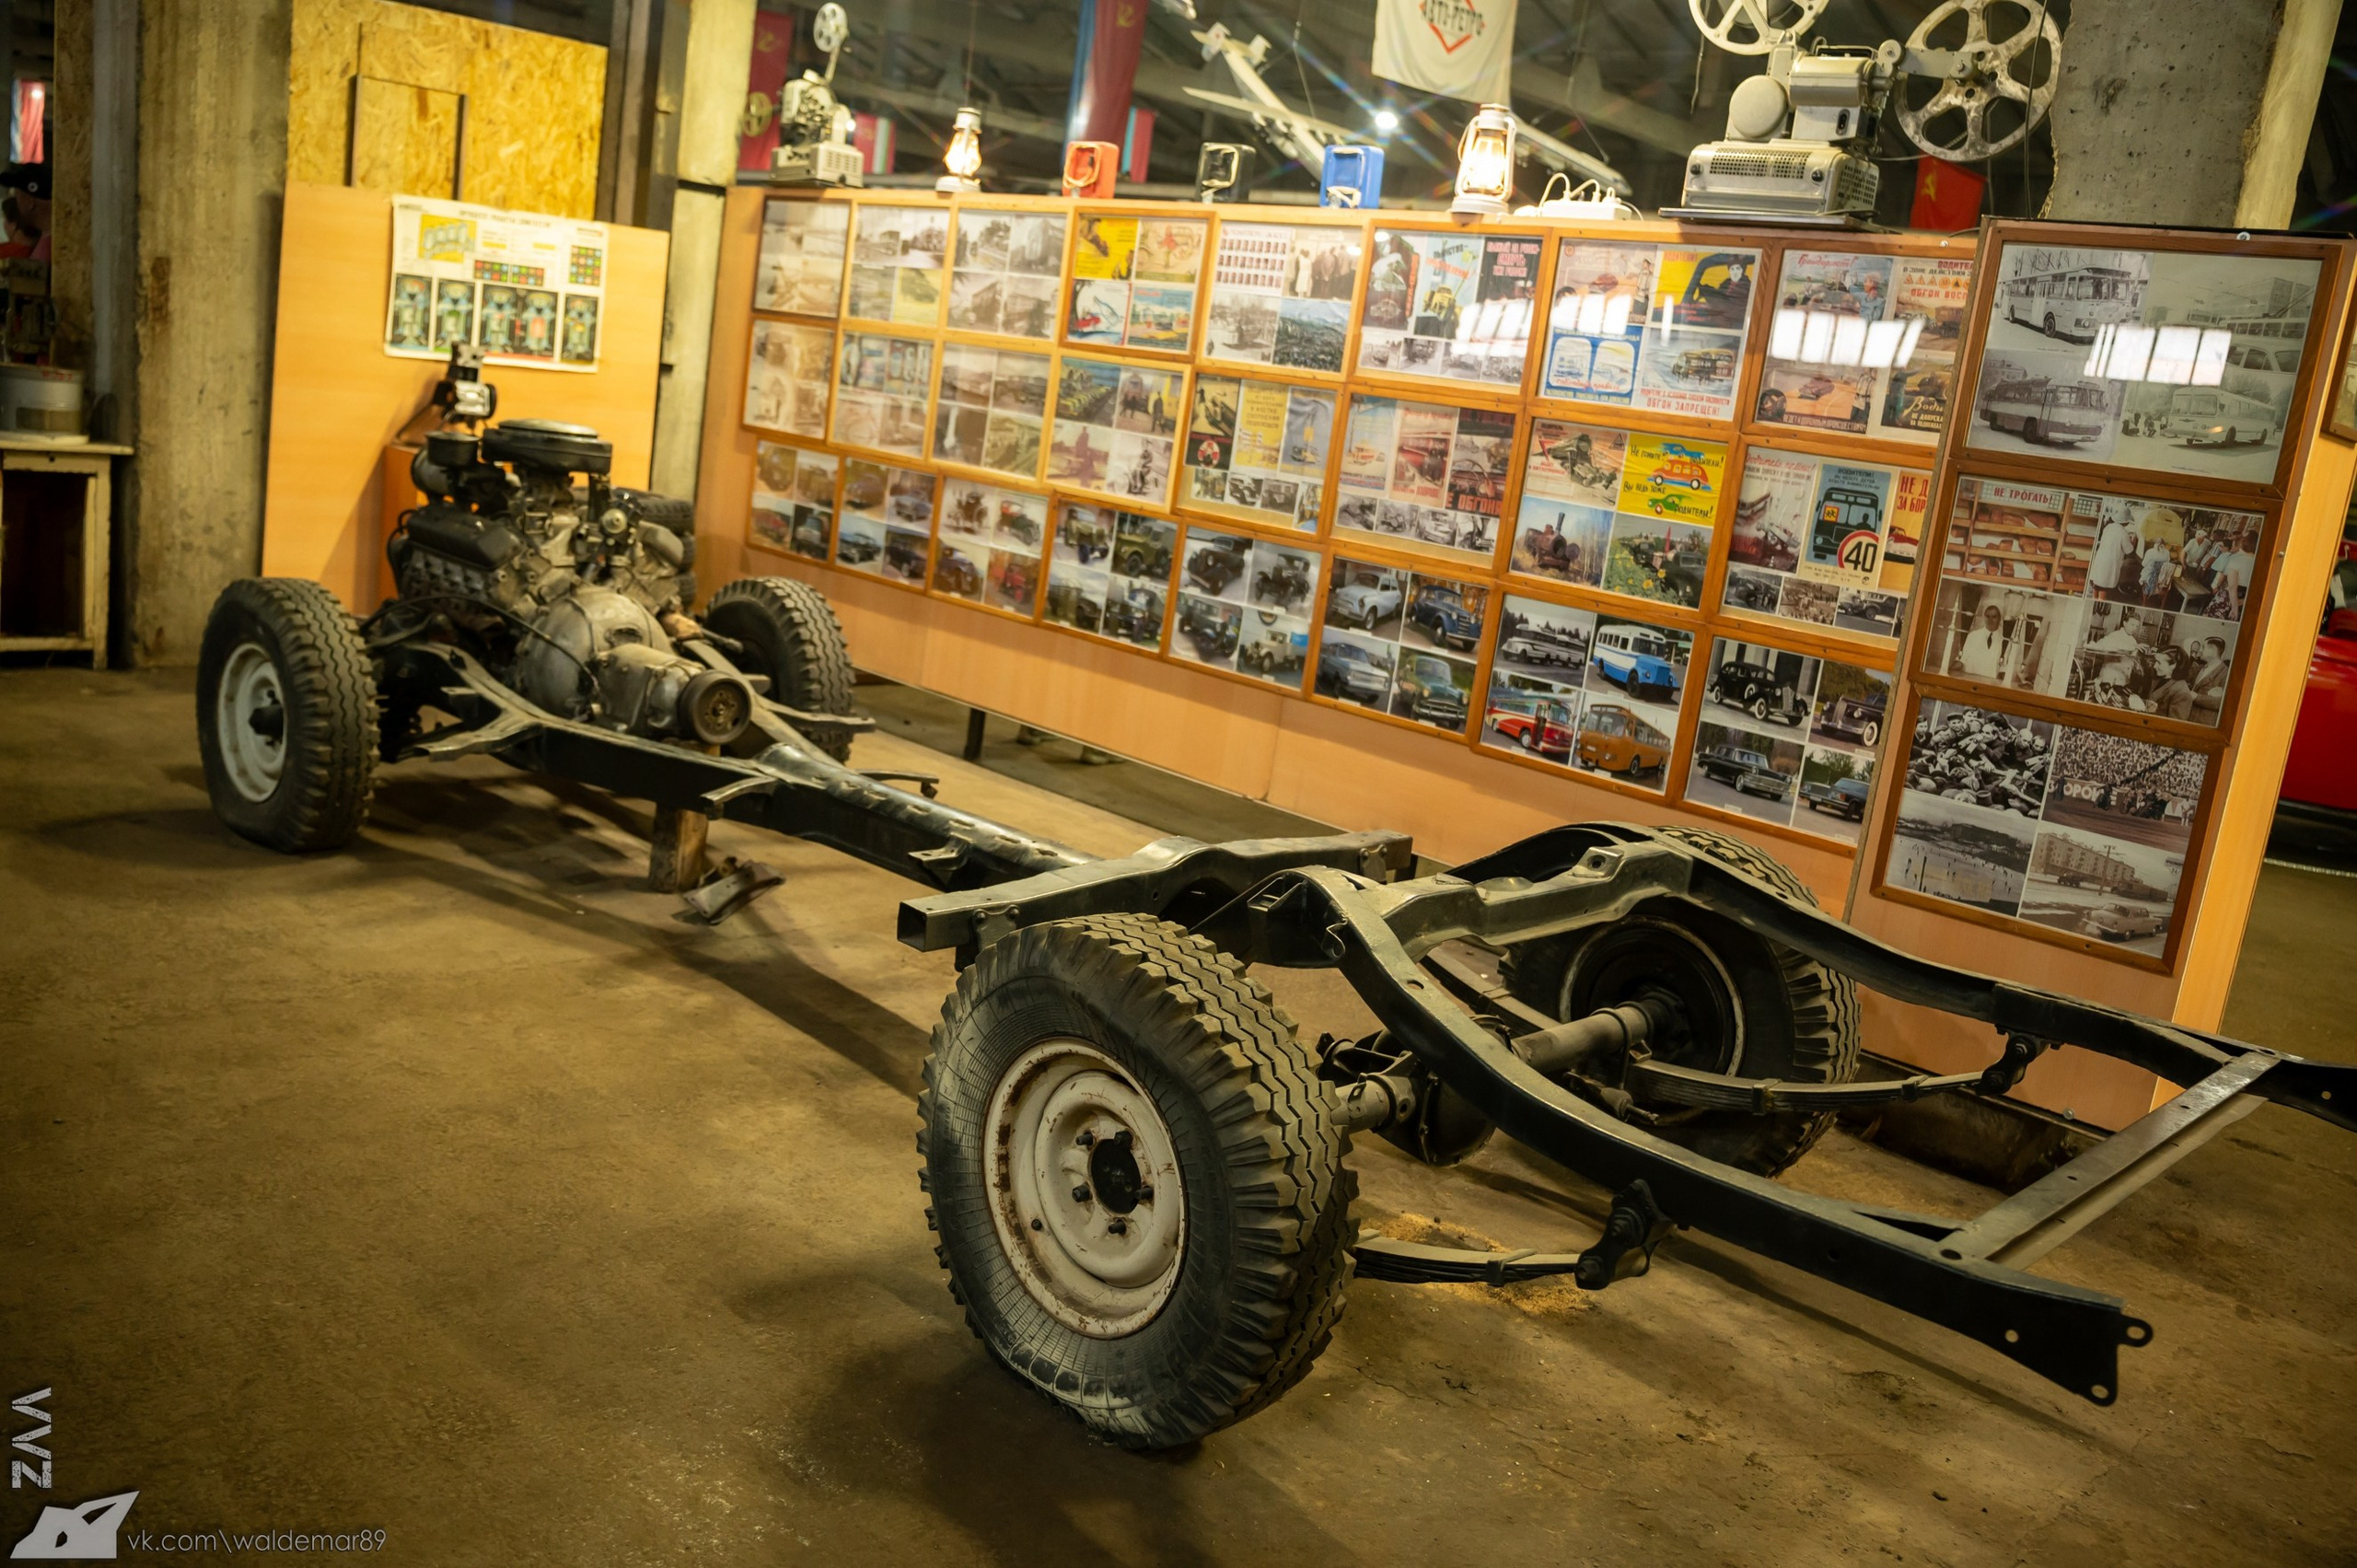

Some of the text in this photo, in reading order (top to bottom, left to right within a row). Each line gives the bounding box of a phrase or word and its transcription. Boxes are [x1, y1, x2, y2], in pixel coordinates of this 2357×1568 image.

[1910, 288, 1940, 299] ОБГОН
[1646, 398, 1720, 416] ОБГОН ЗАПРЕЩЕН!
[1899, 475, 1914, 494] НЕ
[1897, 495, 1908, 511] ЗА
[1993, 486, 2053, 505] НЕ ТРОГАТЬ!
[1675, 505, 1713, 519] РОДИТЕЛИ!
[1844, 540, 1878, 574] 40
